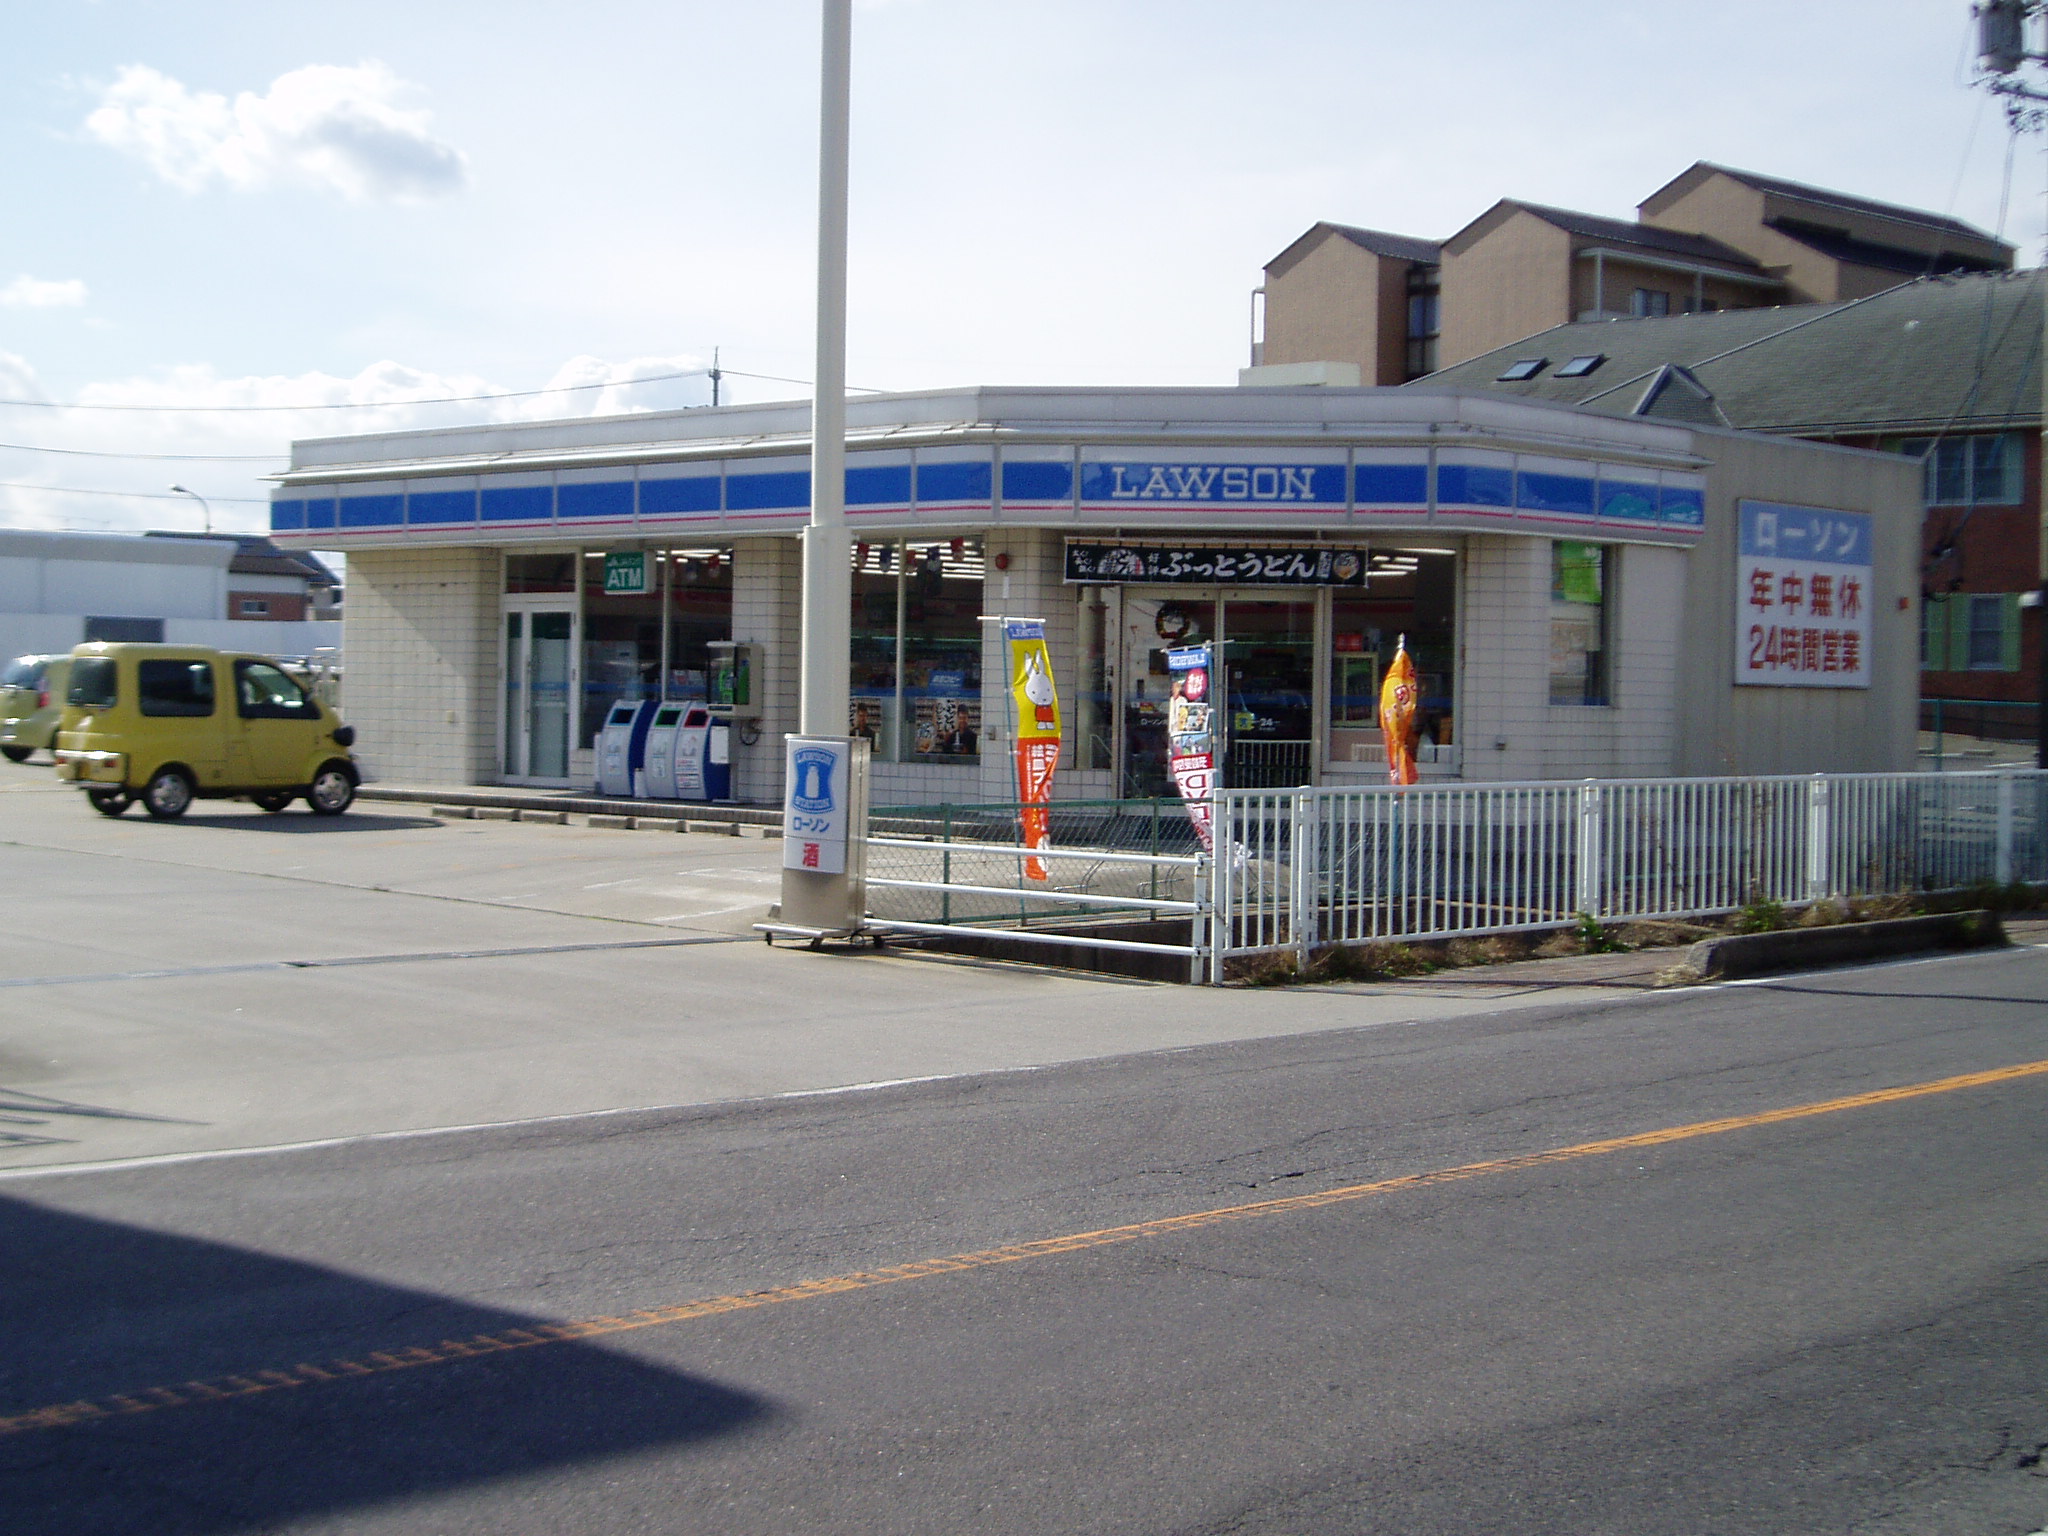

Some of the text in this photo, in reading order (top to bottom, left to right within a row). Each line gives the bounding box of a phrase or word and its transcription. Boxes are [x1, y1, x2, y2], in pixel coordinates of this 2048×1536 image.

[1111, 466, 1316, 499] LAWSON
[1755, 512, 1859, 557] ローソン
[607, 568, 641, 587] ATM
[1160, 551, 1315, 578] ぶっとうどん
[1749, 567, 1862, 619] 年中無休
[1749, 624, 1861, 673] 24時間営業
[1259, 717, 1274, 727] 24
[793, 816, 830, 833] ローソン
